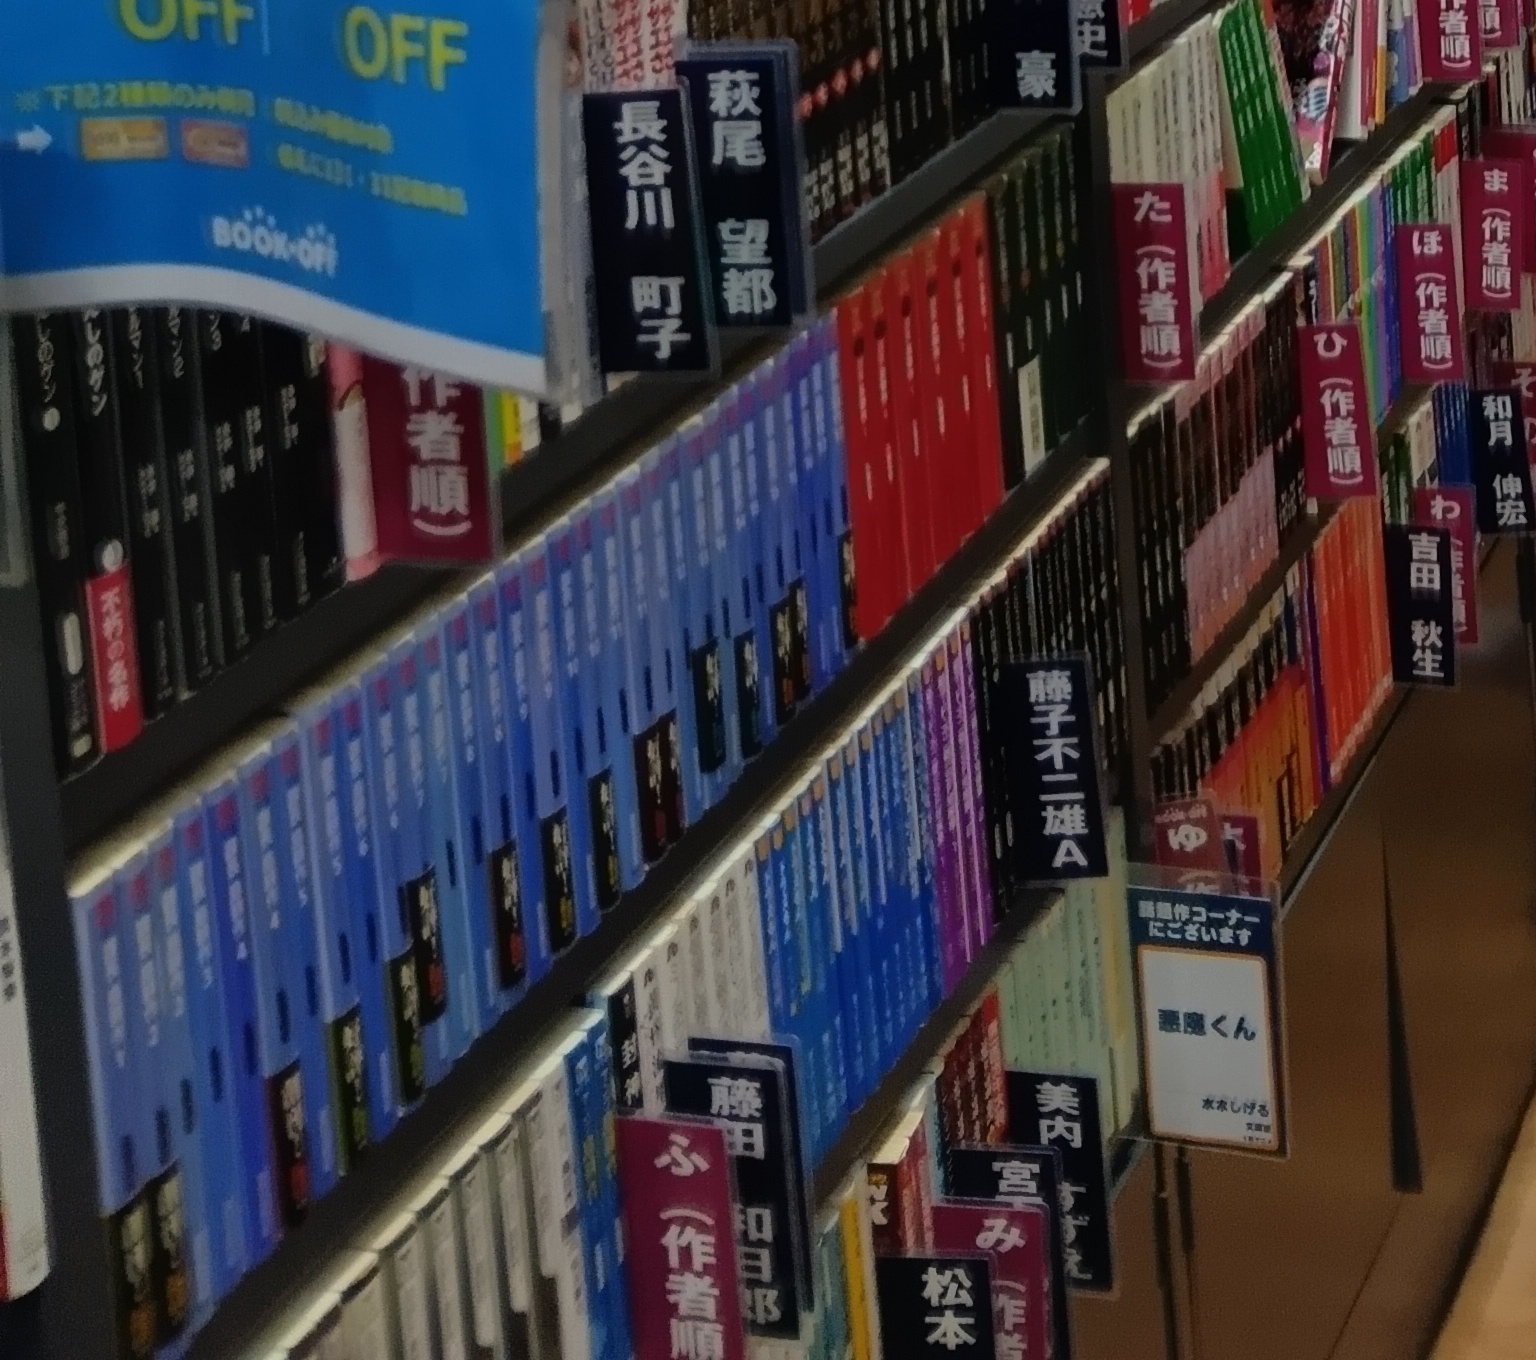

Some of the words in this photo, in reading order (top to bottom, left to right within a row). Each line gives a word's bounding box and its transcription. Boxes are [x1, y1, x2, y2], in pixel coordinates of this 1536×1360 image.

[343, 6, 469, 91] OFF
[1133, 192, 1184, 370] た（作者順）
[1412, 230, 1455, 371] ほ（作者順）
[1313, 332, 1364, 487] ひ（作者順）
